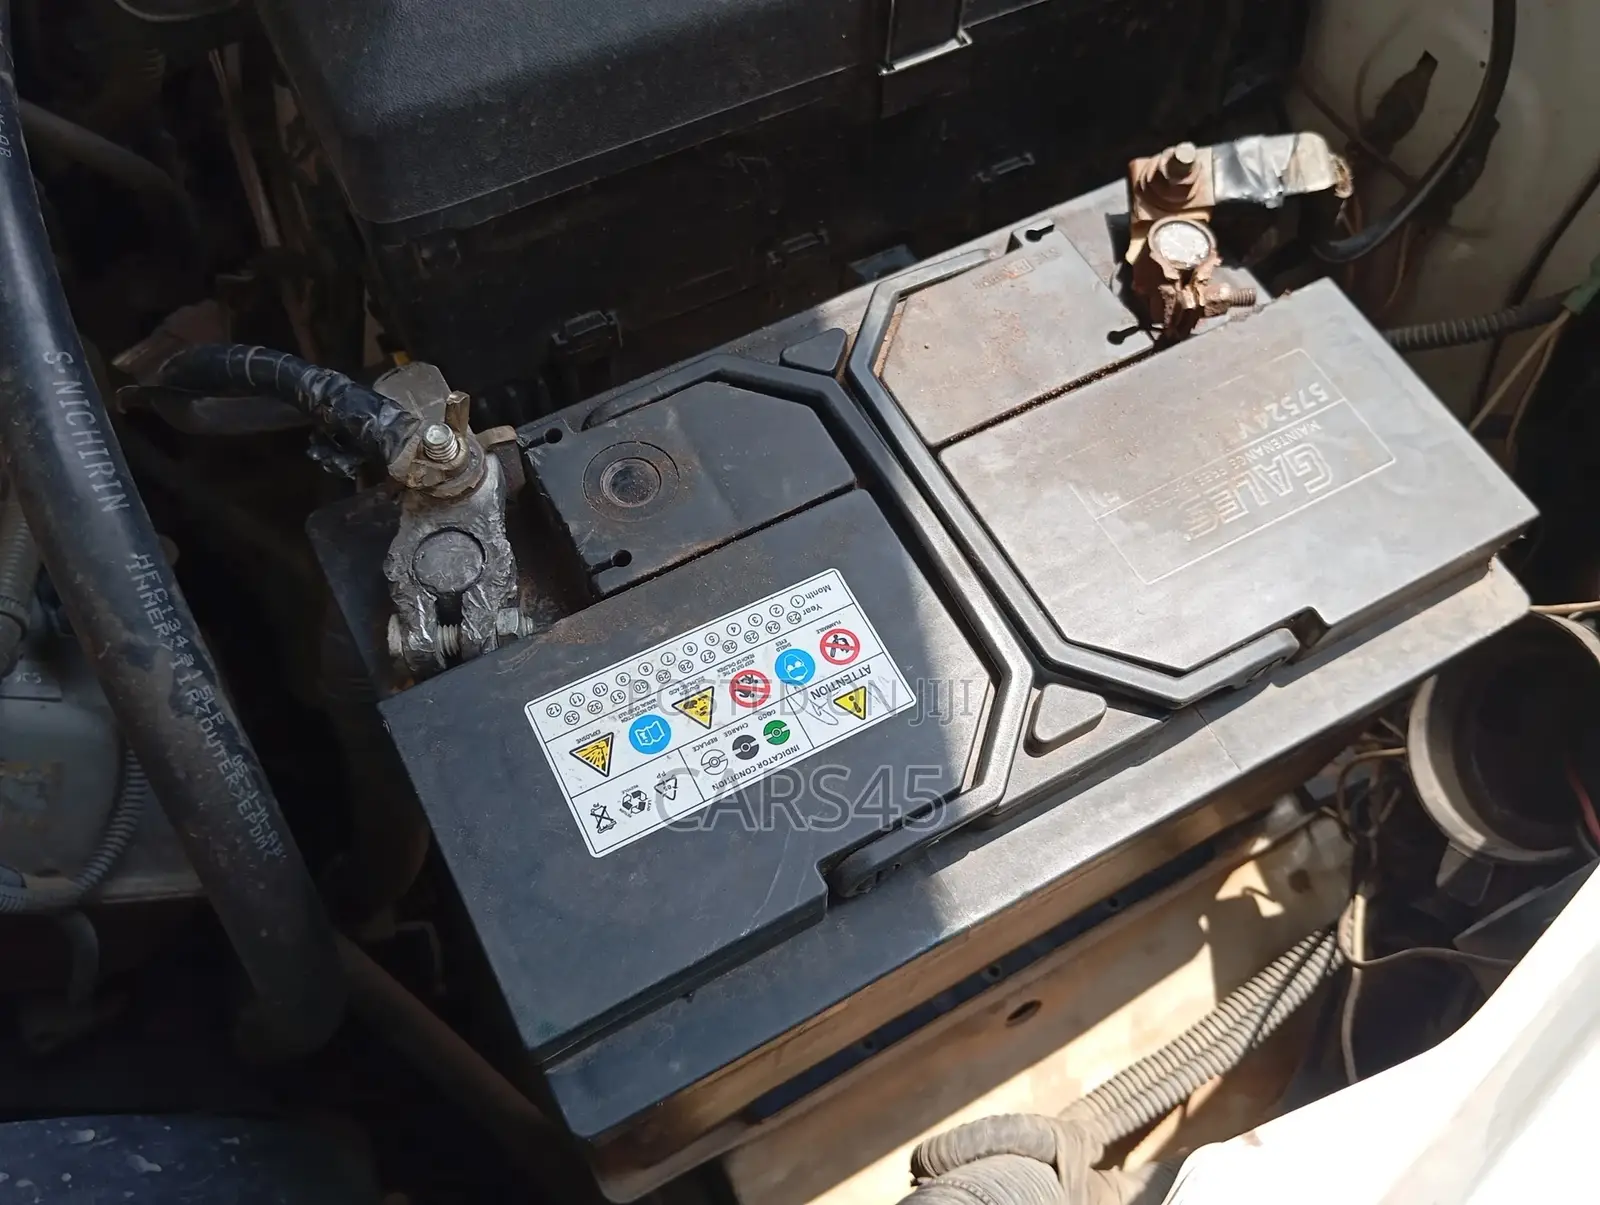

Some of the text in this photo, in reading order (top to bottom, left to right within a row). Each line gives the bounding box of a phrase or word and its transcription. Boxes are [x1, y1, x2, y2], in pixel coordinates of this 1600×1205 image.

[804, 583, 832, 600] Month
[801, 601, 823, 616] Year
[808, 663, 873, 700] ATTENTION
[722, 721, 749, 737] CHARGE
[691, 736, 718, 752] REPLACE
[710, 743, 800, 791] INDICATOR CONDITION
